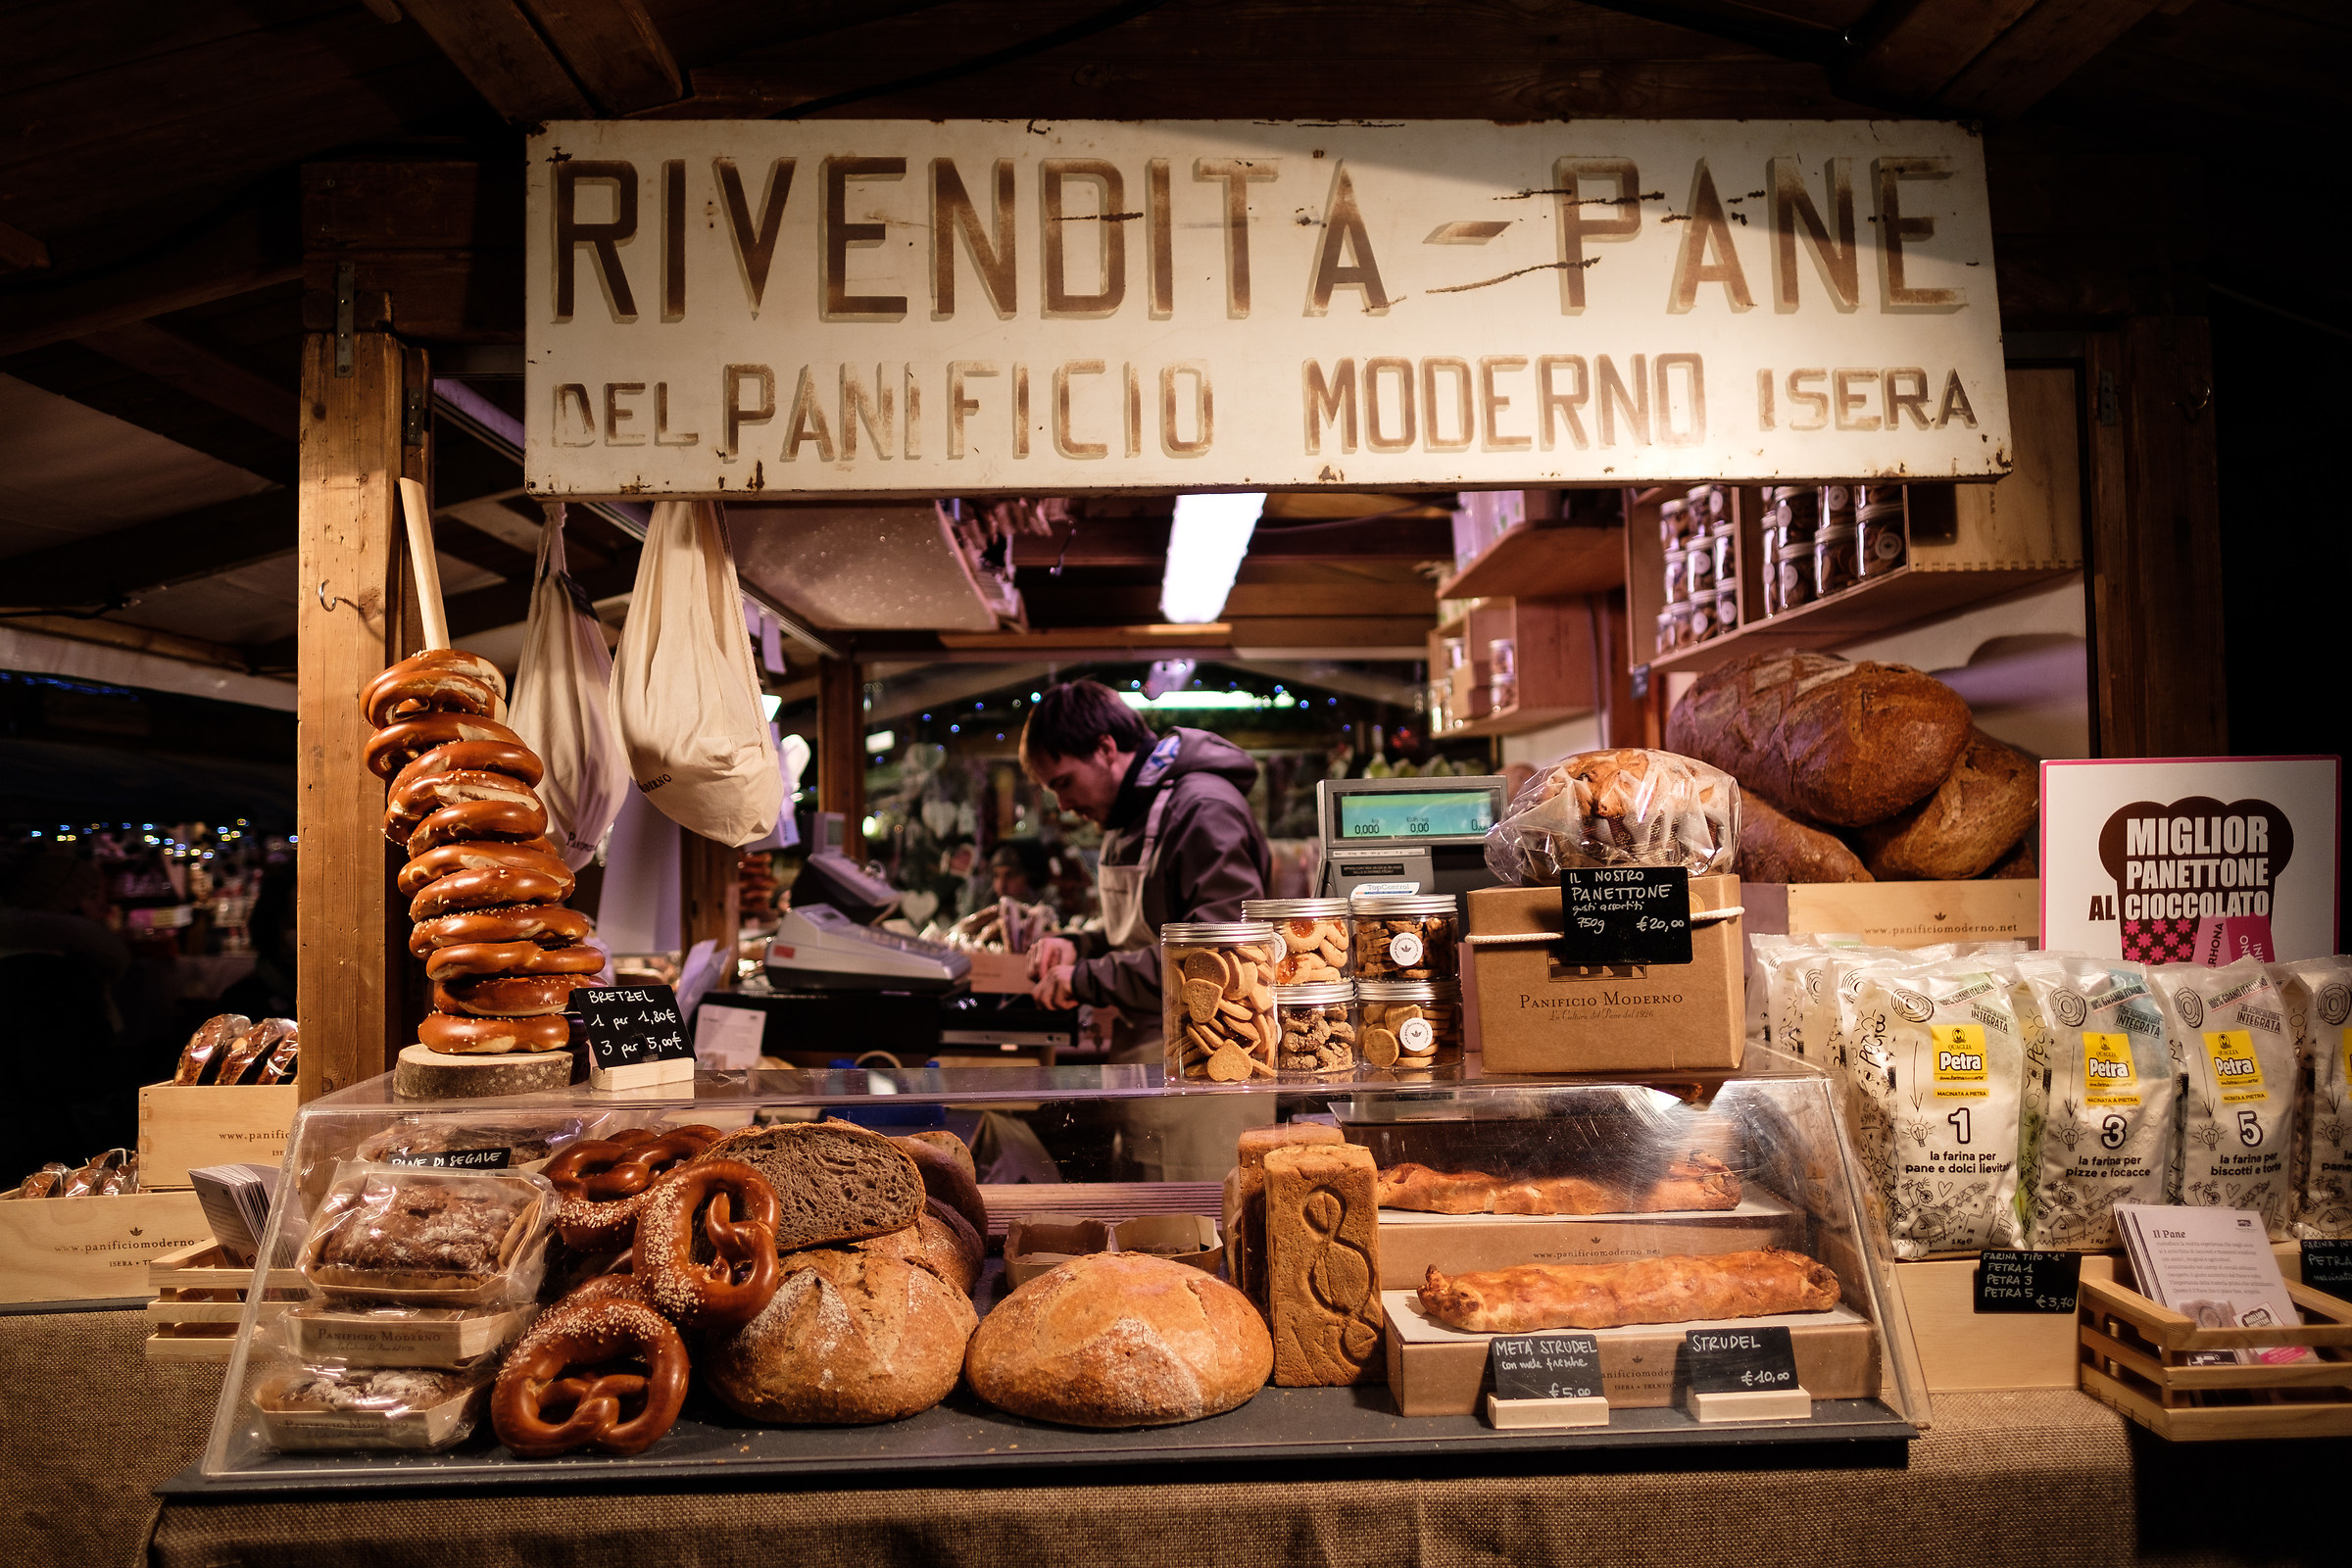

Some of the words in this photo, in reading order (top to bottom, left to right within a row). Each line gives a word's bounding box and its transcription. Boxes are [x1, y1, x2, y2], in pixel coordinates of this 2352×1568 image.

[551, 155, 1391, 324] RIVENDITA
[1552, 156, 1969, 316] PANE
[551, 381, 700, 449] DEL
[722, 360, 1216, 465] PANIFICIO
[1303, 352, 1708, 455] MODERNO
[1756, 367, 1980, 431] ISERA
[1410, 822, 1430, 833] 0,00
[2126, 814, 2270, 857] MIGLIOR
[1569, 872, 1582, 884] IL
[1594, 869, 1644, 882] NOSTRO
[2126, 858, 2270, 890] PANETTONE
[1367, 883, 1410, 892] TopControl
[1571, 884, 1673, 902] PANETTONE
[2088, 895, 2117, 921] AL
[2124, 889, 2270, 920] CIOCCOLATO
[1577, 916, 1605, 935] 750g
[1864, 920, 2019, 938] www.panificiomoderno.net
[2208, 923, 2225, 967] RHONA
[588, 989, 655, 1004] BRETZEL
[590, 1014, 605, 1028] 1
[612, 1016, 629, 1031] per
[637, 1007, 677, 1025] 1,80€
[1970, 1009, 2008, 1033] INTEGRATA
[2115, 1013, 2161, 1038] INTEGRATA
[2235, 1010, 2281, 1033] INTEGRATA
[601, 1040, 613, 1056] 3
[620, 1042, 639, 1058] per
[1938, 1051, 1983, 1071] Petra
[2088, 1056, 2131, 1078] Petra
[2213, 1056, 2255, 1076] Petra
[1947, 1106, 1971, 1145] 1
[2100, 1113, 2128, 1150] 3
[2237, 1109, 2264, 1148] 5
[433, 1156, 445, 1167] DI
[449, 1152, 503, 1167] SEGALE
[1930, 1151, 1939, 1161] la
[1943, 1151, 1976, 1161] farina
[1979, 1152, 1996, 1164] per
[2078, 1155, 2088, 1166] la
[2091, 1155, 2121, 1166] farina
[2124, 1155, 2142, 1168] per
[2220, 1154, 2230, 1165] la
[2232, 1153, 2262, 1164] farina
[2264, 1152, 2278, 1165] per
[1905, 1164, 1936, 1174] pane
[1948, 1162, 1976, 1174] dolci
[2065, 1167, 2098, 1178] pizze
[2100, 1169, 2107, 1178] e
[2110, 1167, 2151, 1178] focacce
[2210, 1165, 2253, 1176] biscotti
[2152, 1229, 2161, 1239] Il
[2162, 1229, 2186, 1239] Pane
[1533, 1248, 1662, 1260] www.panificiomoderno.net
[1983, 1251, 2018, 1261] FARINA
[2022, 1252, 2043, 1261] TIPO
[1987, 1262, 2022, 1273] PETRA
[2023, 1262, 2034, 1273] 1
[1985, 1273, 2021, 1286] PETRA
[2024, 1275, 2034, 1286] 3
[1984, 1286, 2022, 1298] PETRA
[2024, 1288, 2034, 1298] 5
[1540, 1339, 1598, 1355] STRUDEL
[1692, 1334, 1762, 1352] STRUDEL
[1501, 1359, 1518, 1372] con
[1519, 1356, 1544, 1370] mele
